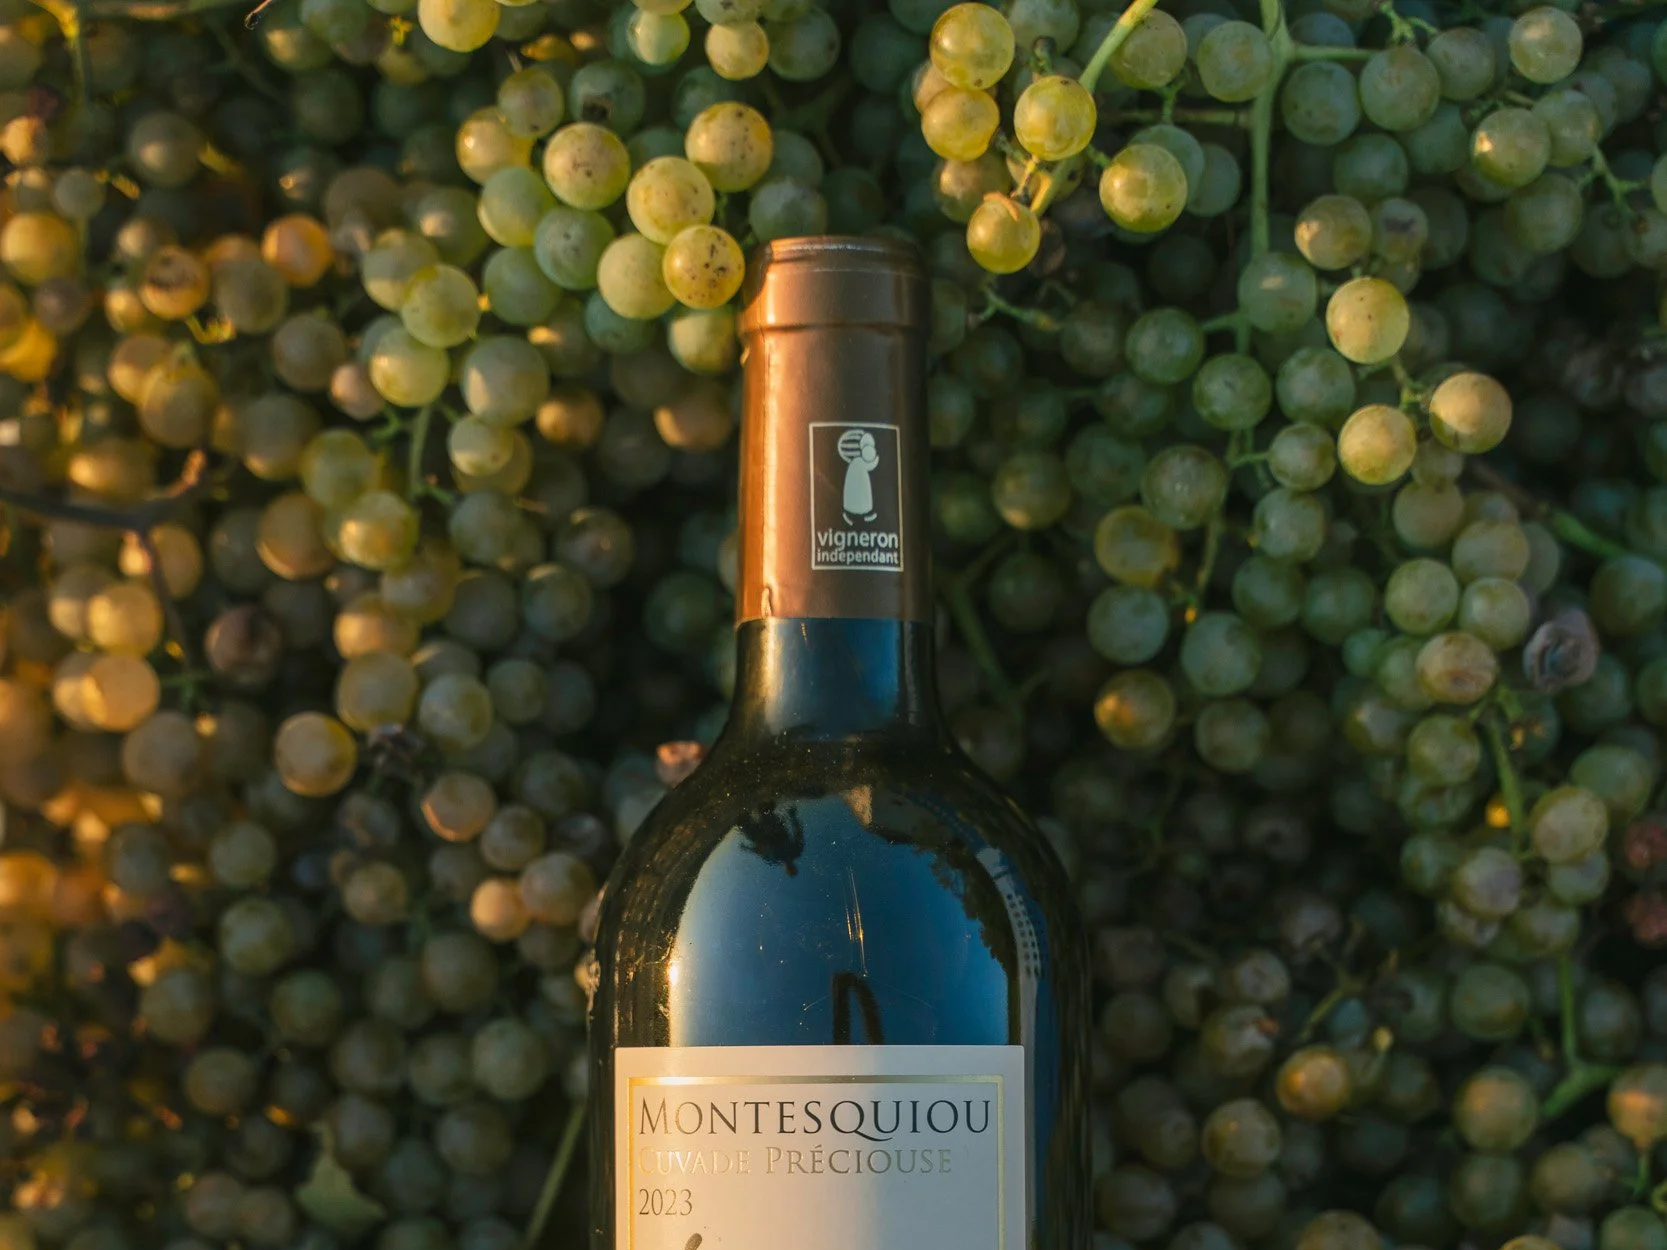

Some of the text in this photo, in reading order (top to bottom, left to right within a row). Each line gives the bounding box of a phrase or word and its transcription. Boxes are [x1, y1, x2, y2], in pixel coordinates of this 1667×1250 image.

[817, 528, 899, 551] vigneron
[638, 1096, 991, 1142] MONTESQUIOU
[638, 1144, 952, 1175] CUVADE PRÉCIOUSE
[638, 1188, 693, 1216] 2023
